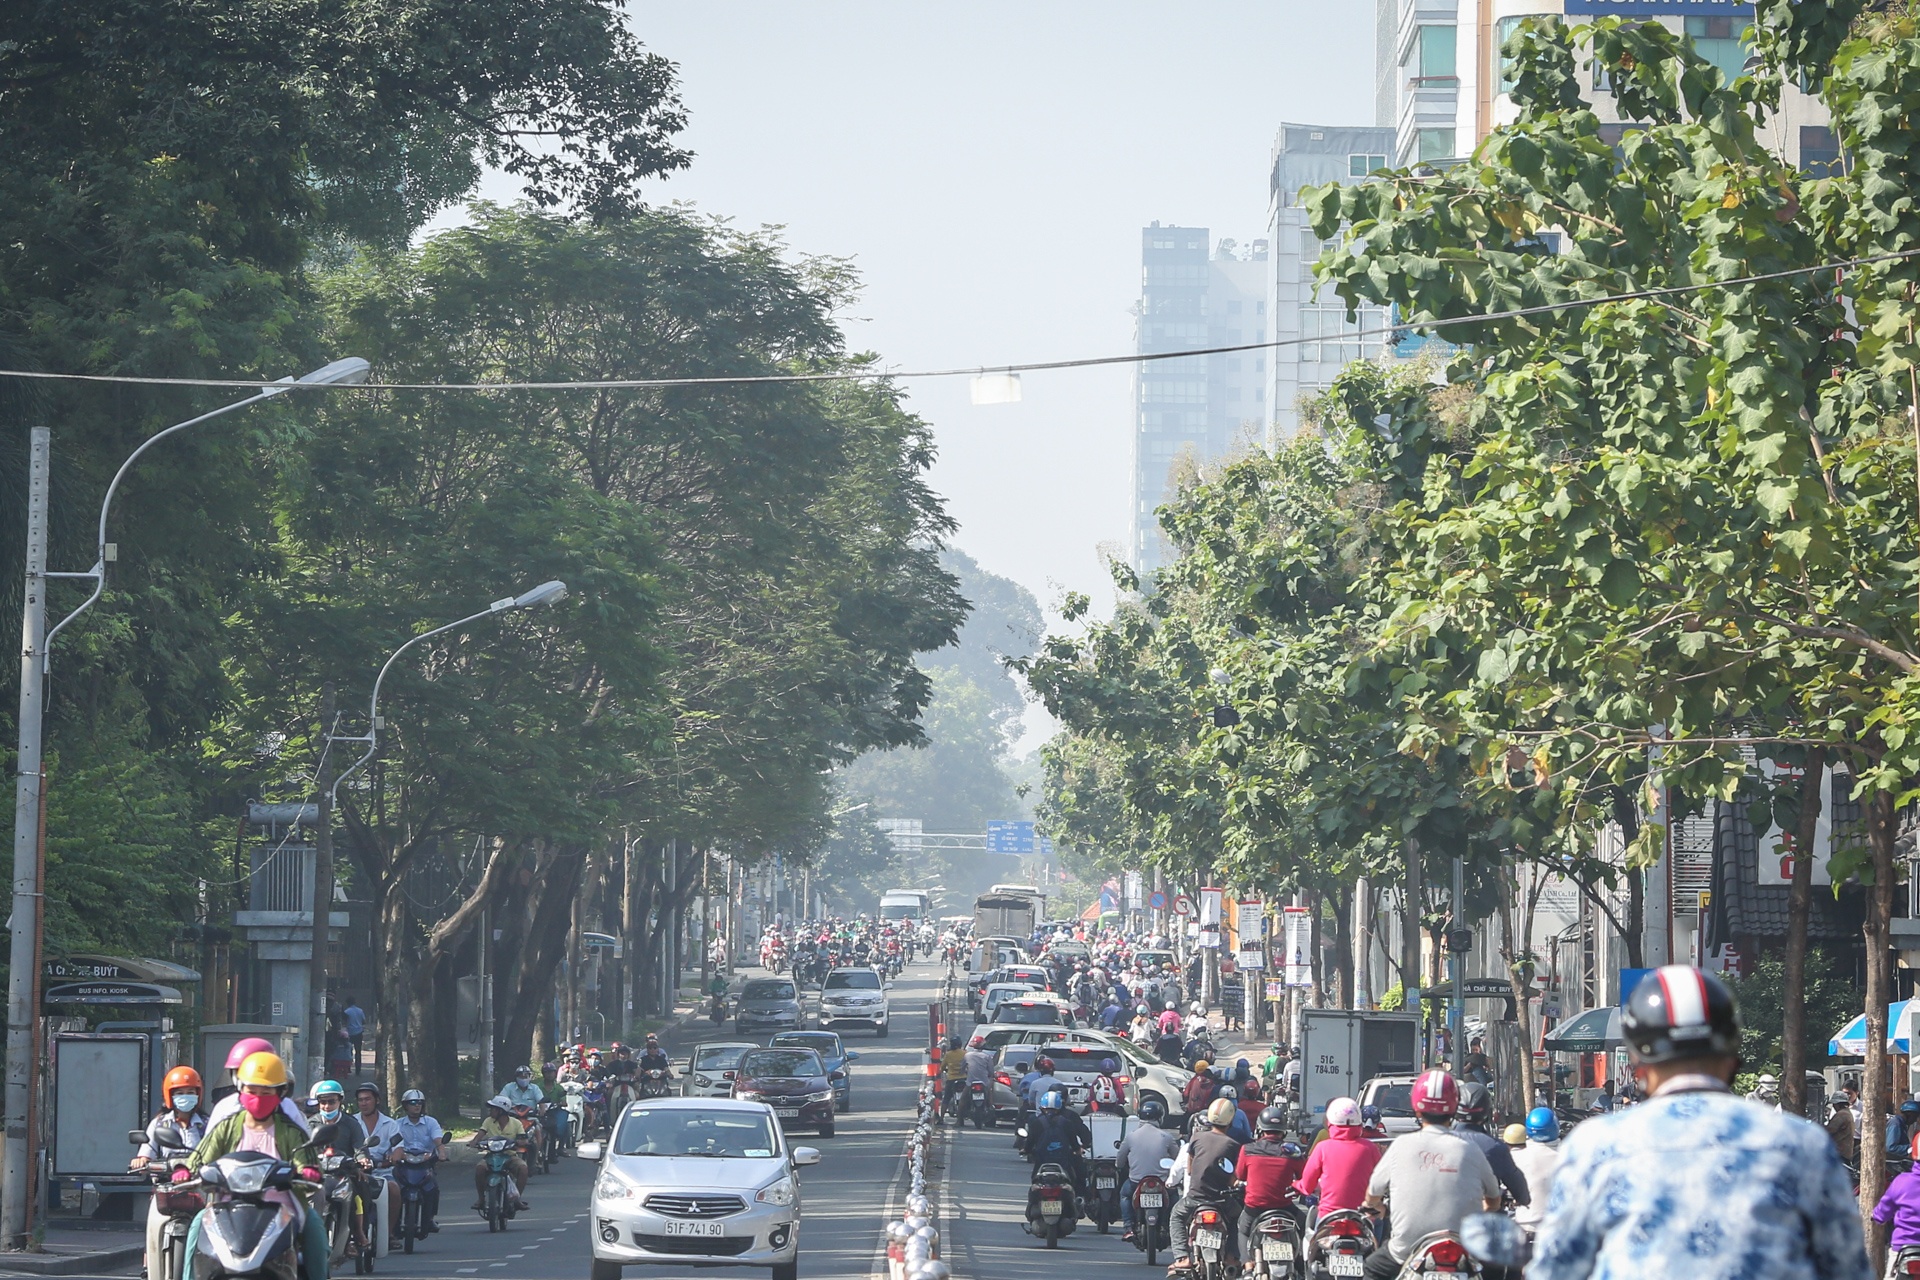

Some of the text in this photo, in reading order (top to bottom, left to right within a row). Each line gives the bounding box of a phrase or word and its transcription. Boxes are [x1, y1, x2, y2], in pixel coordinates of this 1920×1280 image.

[93, 964, 119, 977] BUÝT
[1462, 984, 1471, 992] HÀ
[1488, 985, 1497, 993] XE
[1320, 1054, 1335, 1065] 51C
[1314, 1064, 1340, 1075] 784.06
[667, 1222, 721, 1236] 51F-741.90
[1199, 1237, 1218, 1248] 5331
[1268, 1243, 1288, 1252] 75-E1
[1332, 1265, 1362, 1276] 077.10
